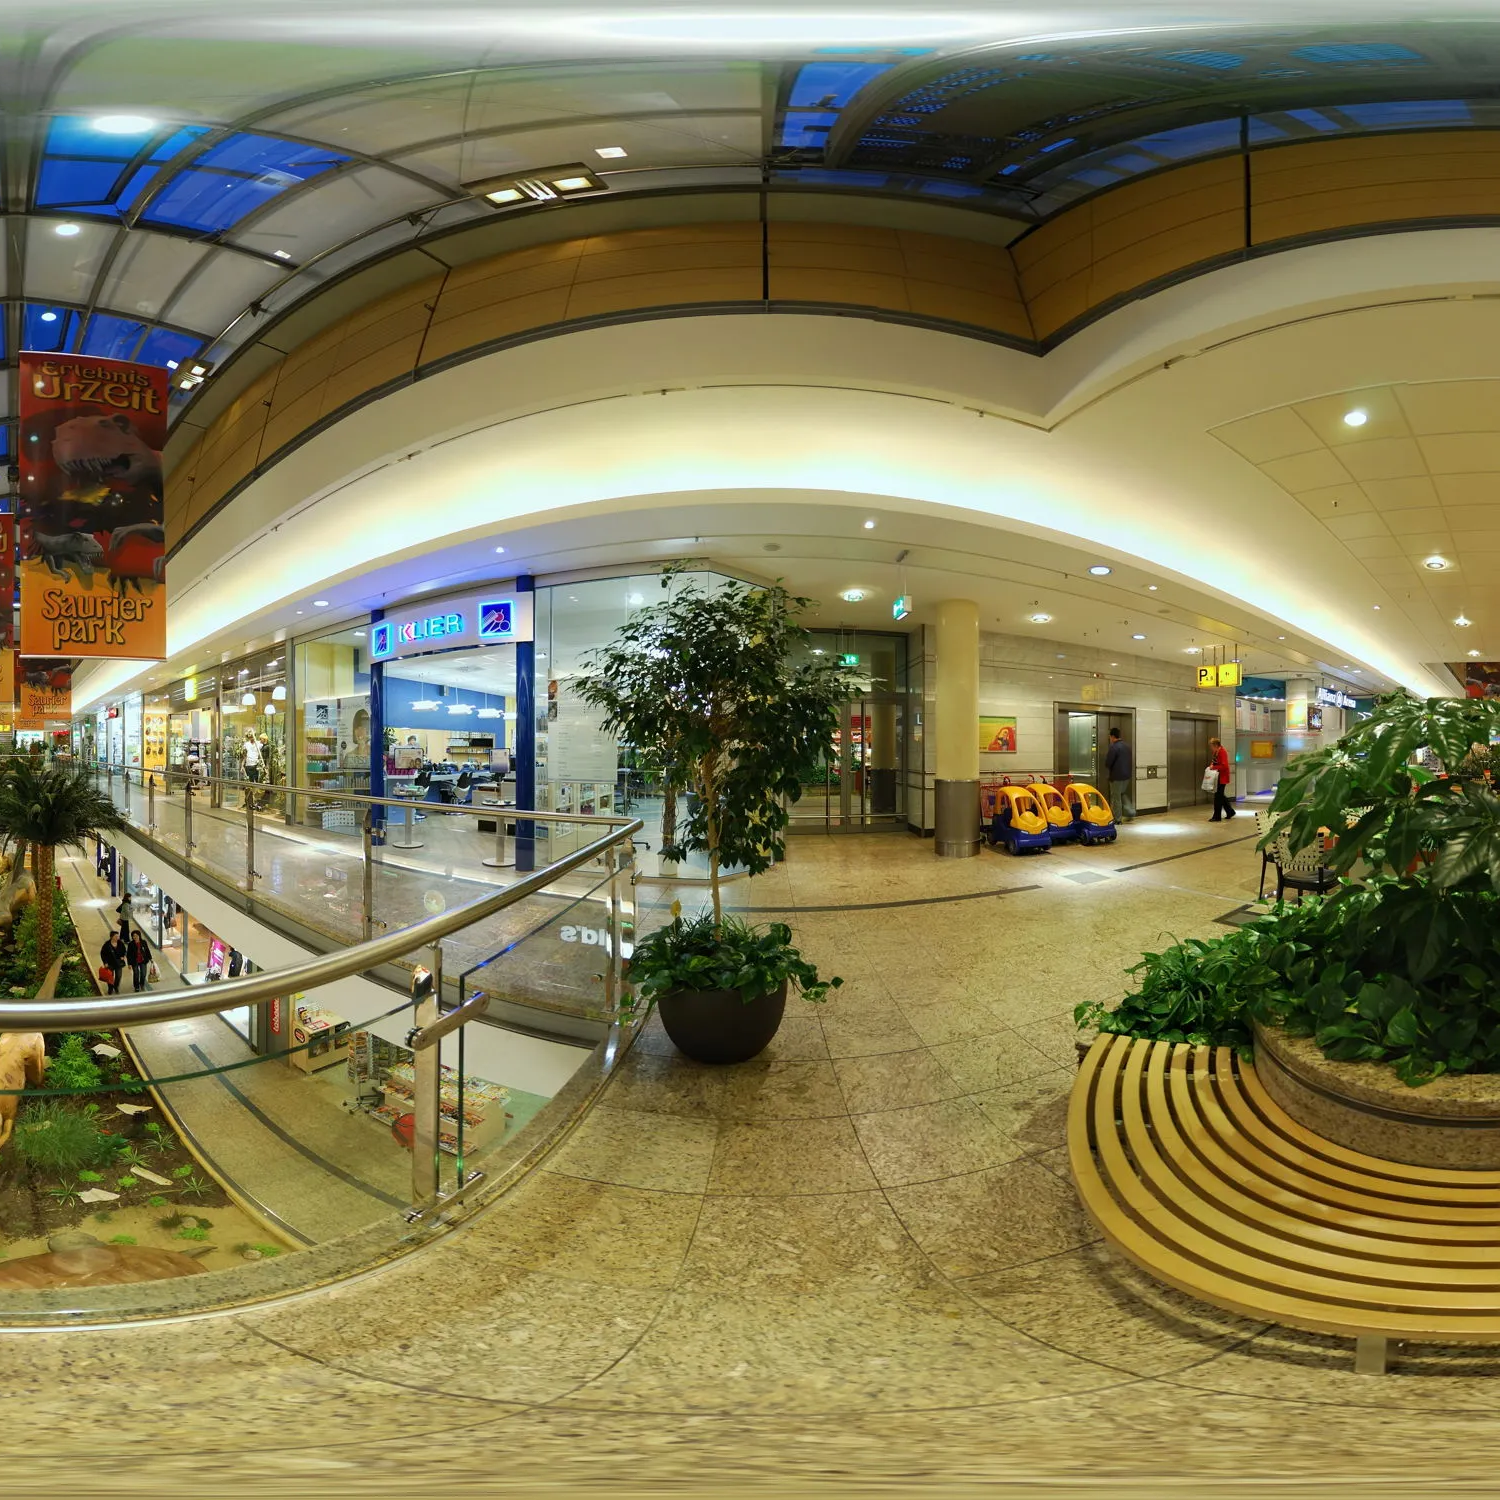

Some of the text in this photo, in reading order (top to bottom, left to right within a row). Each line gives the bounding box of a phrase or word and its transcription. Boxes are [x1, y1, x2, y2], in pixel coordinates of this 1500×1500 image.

[41, 360, 149, 387] Erlebnis
[32, 373, 161, 415] Urzeit
[41, 587, 153, 621] Saurier
[52, 614, 125, 650] park
[399, 613, 463, 643] KLIER
[1199, 669, 1207, 682] P
